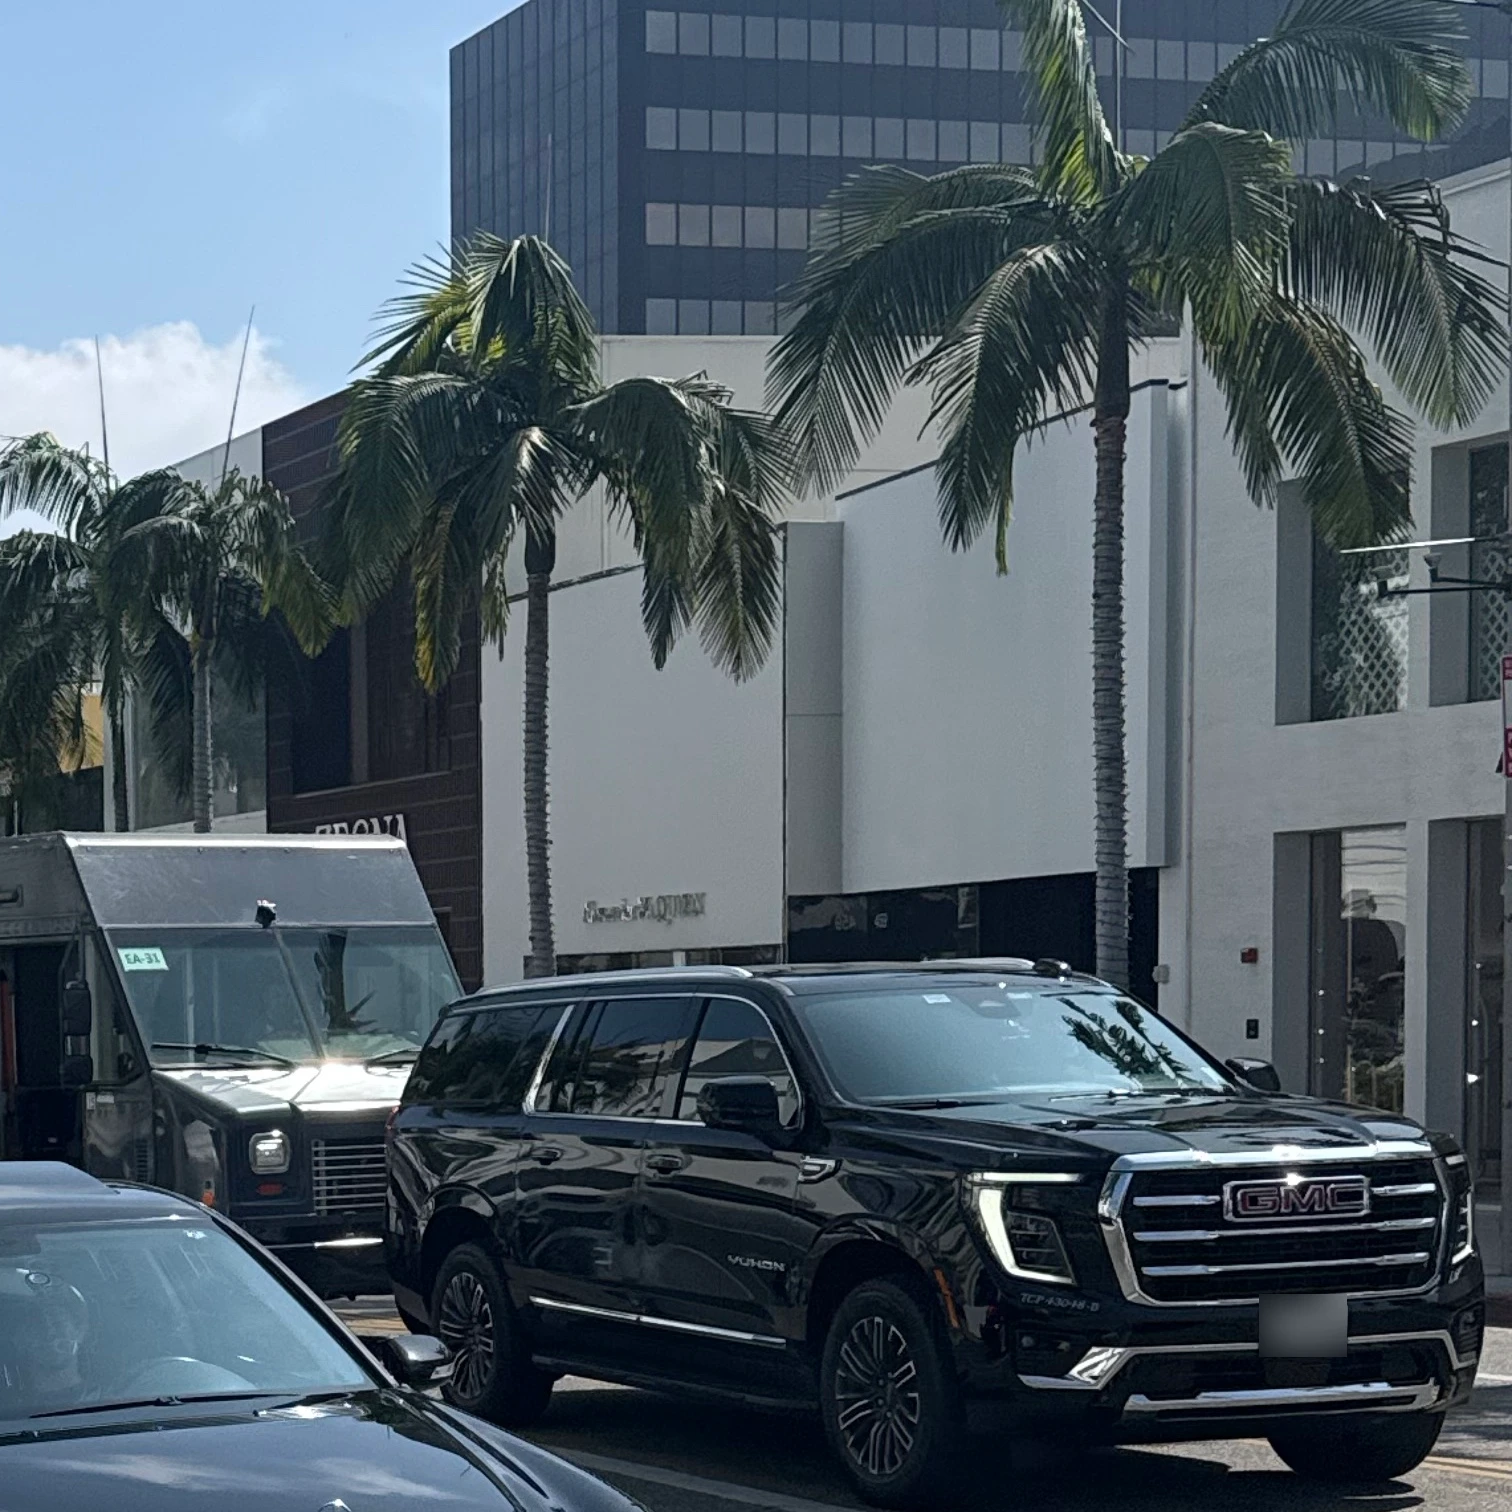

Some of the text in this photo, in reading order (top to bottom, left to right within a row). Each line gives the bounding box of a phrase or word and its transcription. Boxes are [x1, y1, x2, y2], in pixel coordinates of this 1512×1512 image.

[124, 952, 161, 965] EA-31
[1237, 1184, 1366, 1215] GMC
[728, 1254, 787, 1272] YUKON
